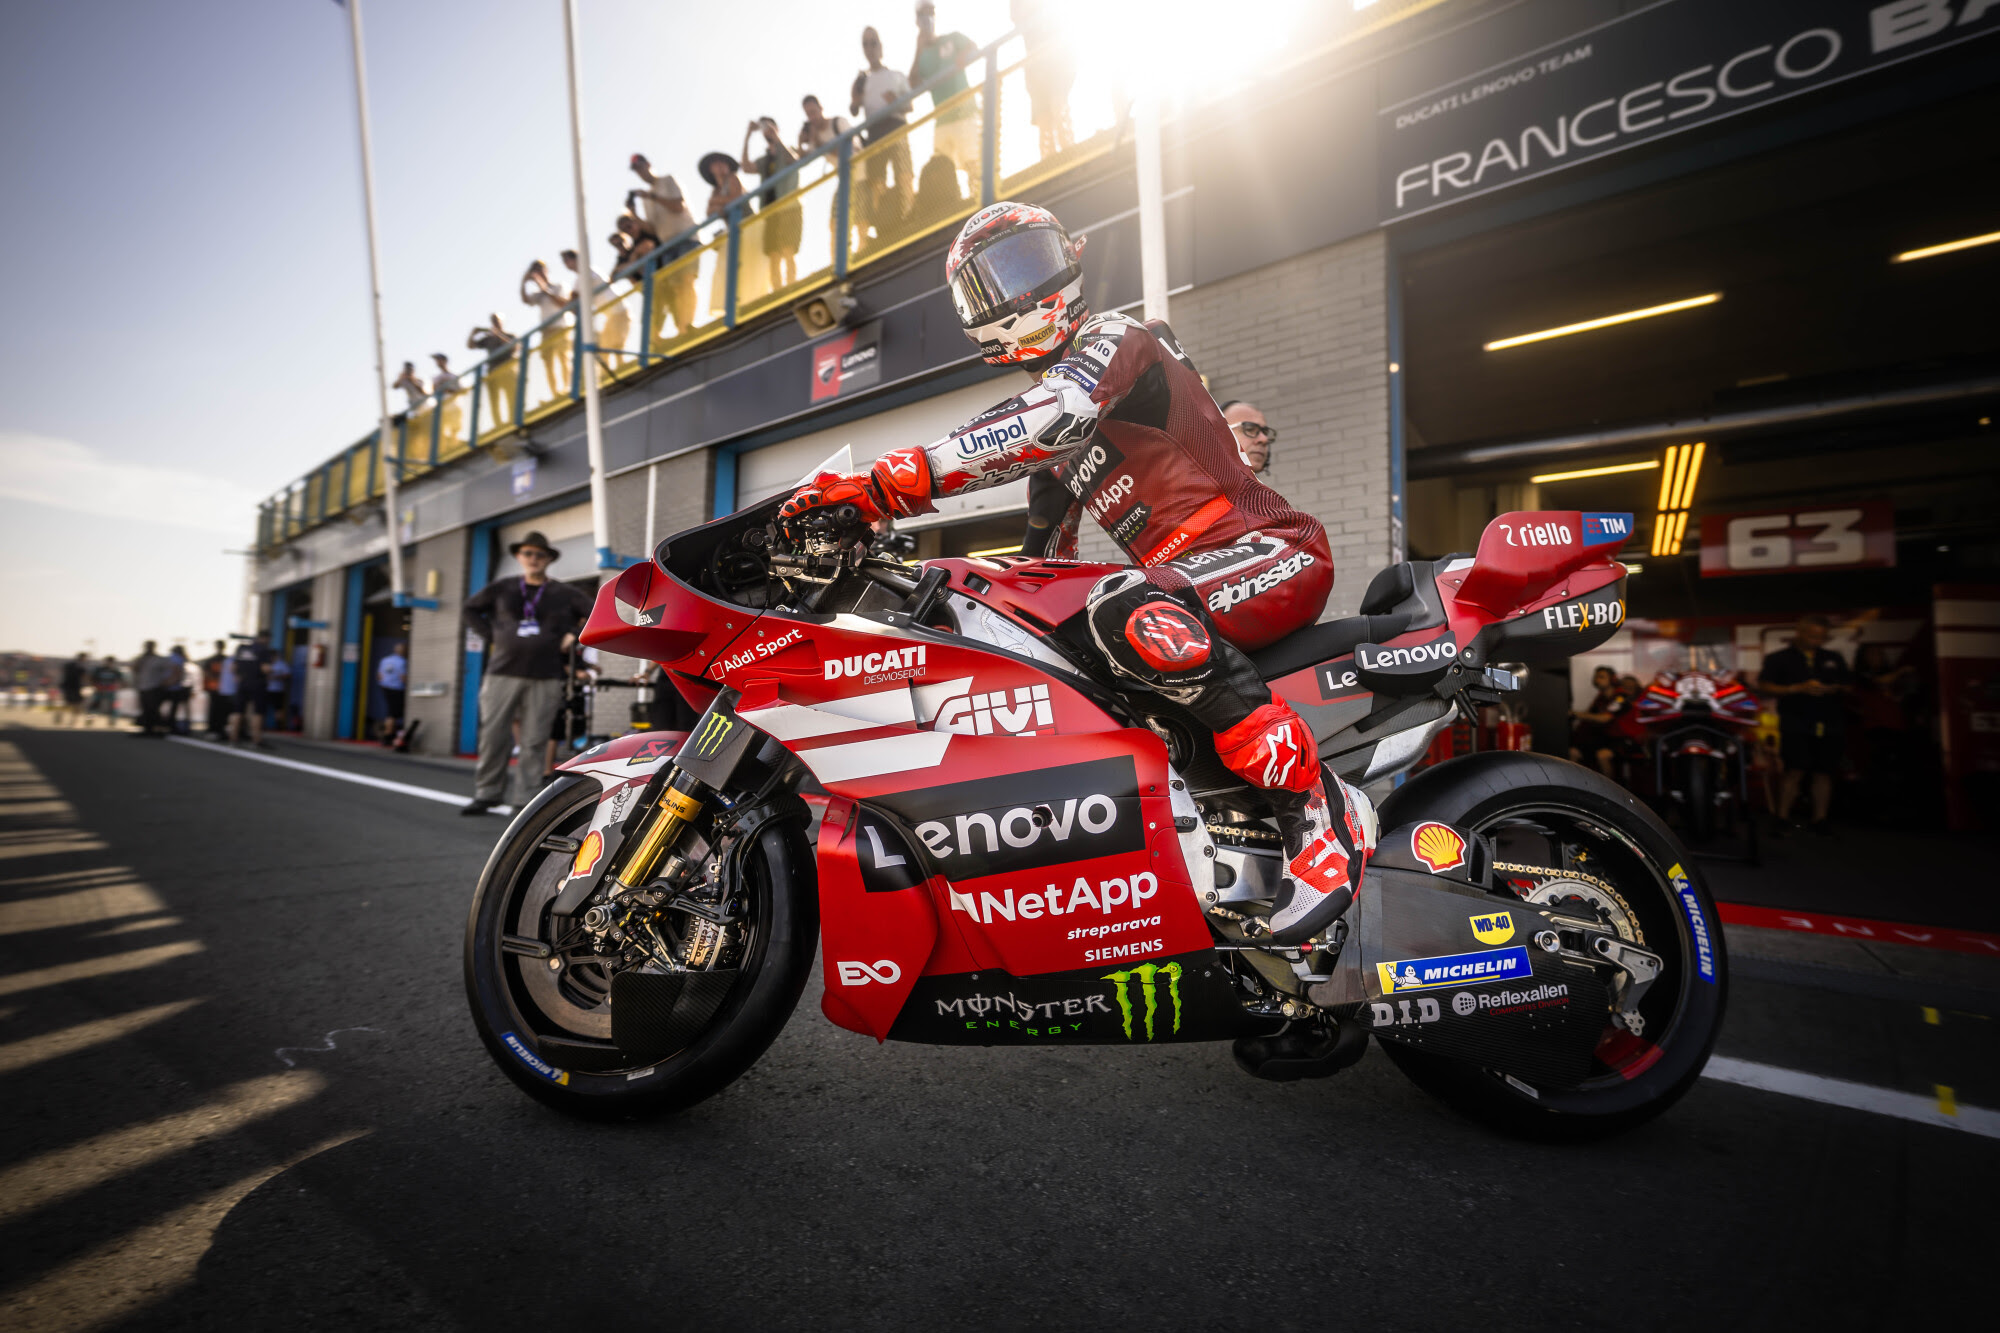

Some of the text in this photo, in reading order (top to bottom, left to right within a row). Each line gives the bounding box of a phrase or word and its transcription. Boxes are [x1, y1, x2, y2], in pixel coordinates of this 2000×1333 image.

[1396, 45, 1592, 128] DUCATI LENOVO TEAM
[1396, 28, 1842, 207] FRANCESCO
[1074, 234, 1087, 252] 63
[1069, 299, 1087, 316] Leno
[1019, 323, 1056, 347] PARMACOTTO
[842, 346, 876, 369] Lenovo
[980, 345, 1002, 356] novo
[1057, 366, 1092, 388] MICHELIN
[954, 403, 1019, 434] Lenovo
[958, 415, 1028, 455] Unipol
[1089, 474, 1134, 522] NtApp
[1519, 522, 1572, 547] riello
[1600, 518, 1627, 534] TIM
[1727, 508, 1866, 570] 63
[1145, 532, 1190, 569] CIAROSSA
[1207, 550, 1317, 613] alpinestars
[1543, 599, 1627, 633] FLEX-BOX
[724, 628, 803, 672] Audi Sport
[824, 645, 926, 680] DUCATI
[1360, 641, 1457, 670] Lenovo
[863, 667, 926, 685] DESMOSEDICI
[934, 683, 1054, 736] GIVI
[865, 793, 1118, 870] Lenovo
[979, 871, 1159, 924] NetApp
[1067, 915, 1162, 940] streparava
[1473, 914, 1511, 933] WD-40
[1682, 893, 1713, 977] MICHELIN
[1084, 938, 1163, 962] SIEMENS
[1423, 956, 1518, 981] MICHELIN
[935, 992, 1113, 1022] MONSTER
[1478, 984, 1568, 1009] Reflexallen
[1490, 997, 1569, 1016] COMPOSITES DIVISION
[1370, 997, 1441, 1027] D.I.D
[966, 1020, 1083, 1036] ENERGY
[505, 1035, 553, 1075] MICHELIN
